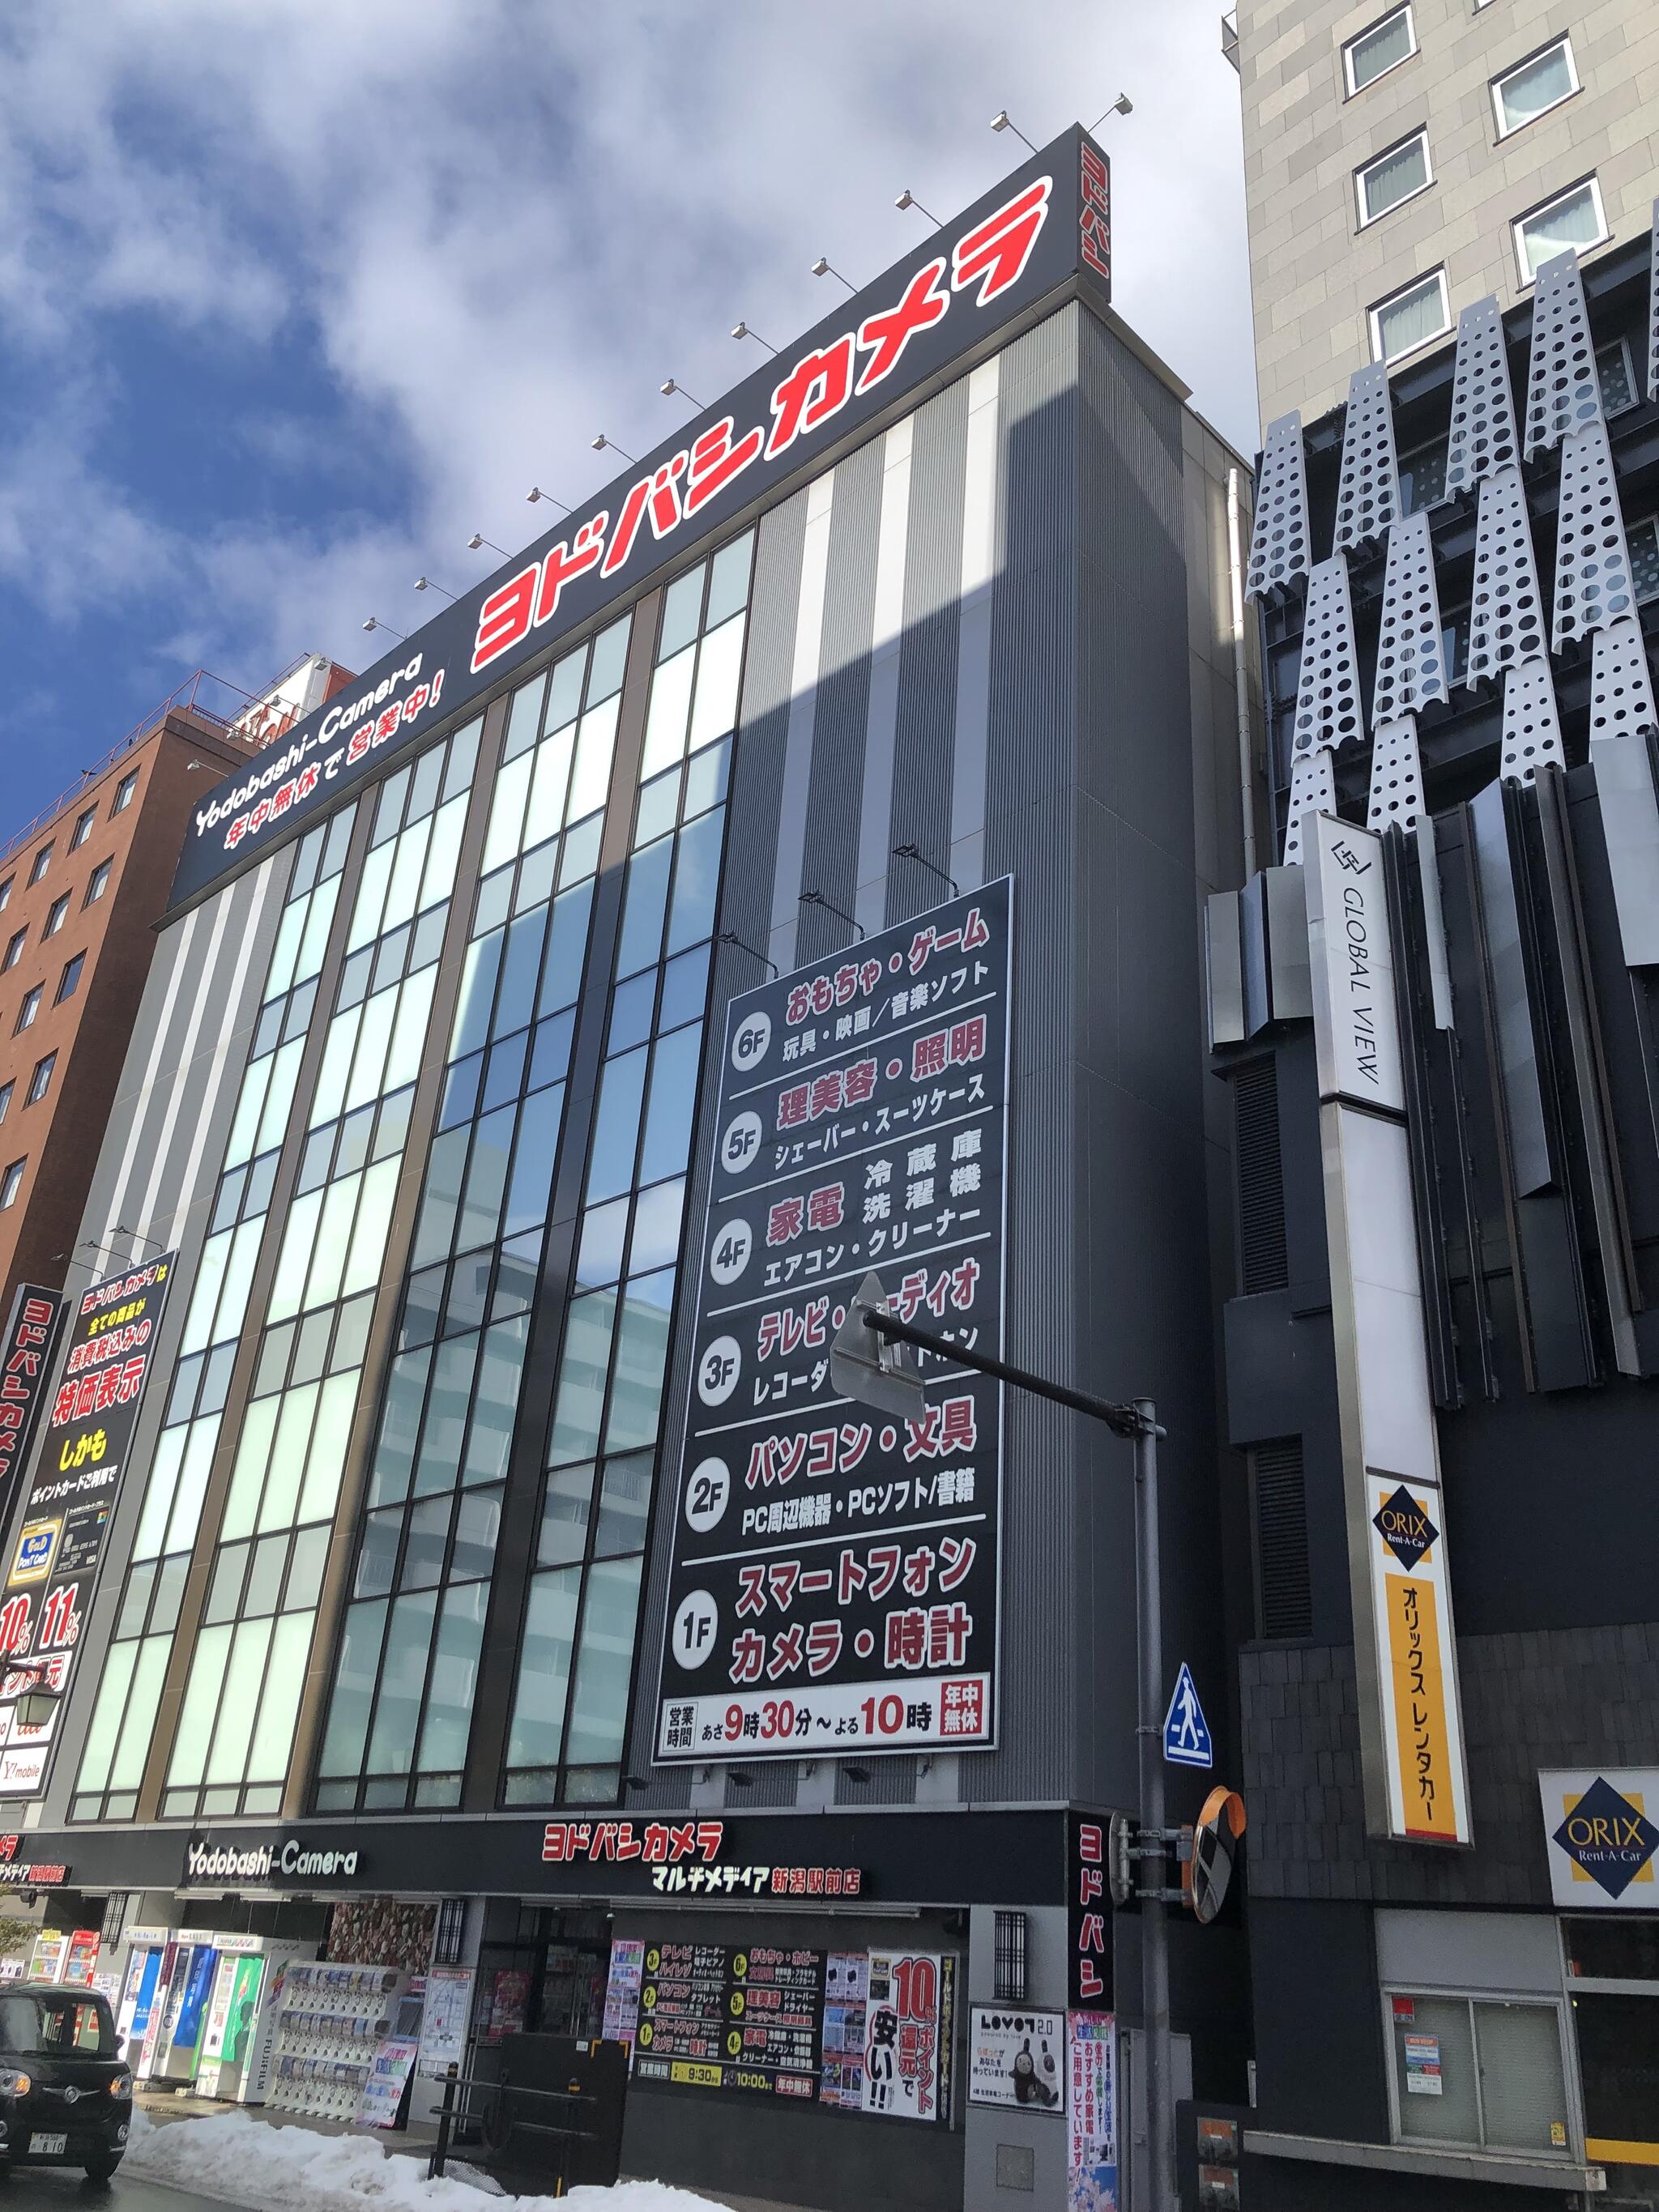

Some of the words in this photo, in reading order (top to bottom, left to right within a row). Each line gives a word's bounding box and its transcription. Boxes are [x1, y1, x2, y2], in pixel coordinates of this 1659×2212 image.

[1079, 141, 1110, 279] ヨドバシ
[470, 175, 1053, 674] ヨドバシカメラ
[196, 653, 423, 837] Yodobashi-Camera
[786, 907, 990, 1026] おもちゃ・ゲーム
[1343, 887, 1371, 992] GLOBAL
[737, 1028, 766, 1059] 6F
[776, 1013, 986, 1132] 理美容・照明
[1353, 1007, 1379, 1085] VIEW
[727, 1128, 757, 1160] 5F
[774, 1073, 985, 1170] シェーバー・スーツケース
[764, 1208, 980, 1287] エアコン・クリーナー
[766, 1182, 844, 1246] 家電
[715, 1238, 746, 1269] 4F
[52, 1354, 147, 1428] 特価表示
[705, 1355, 735, 1390] 3F
[59, 1429, 107, 1472] しかも
[745, 1396, 977, 1490] パソコン・文具
[691, 1477, 723, 1515] 2F
[1382, 1511, 1427, 1538] ORIX
[736, 1536, 976, 1618] スマートフォン
[681, 1612, 712, 1649] 1F
[729, 1601, 973, 1684] カメラ・時計
[1403, 1588, 1426, 1696] オリックス
[669, 1706, 694, 1728] 営業
[943, 1707, 979, 1733] 無休
[945, 1685, 979, 1707] 年中
[667, 1727, 693, 1748] 時間
[1412, 1701, 1435, 1822] レンタカー
[189, 1839, 358, 1876] Yodobashi-Camera
[542, 1822, 723, 1862] ヨドバシカメラ
[1567, 1817, 1645, 1847] ORIX
[1079, 1823, 1105, 1998] ヨドバシ
[981, 2014, 1035, 2034] LOVOT
[1038, 2019, 1053, 2035] 2.0
[916, 2025, 936, 2115] ポイント
